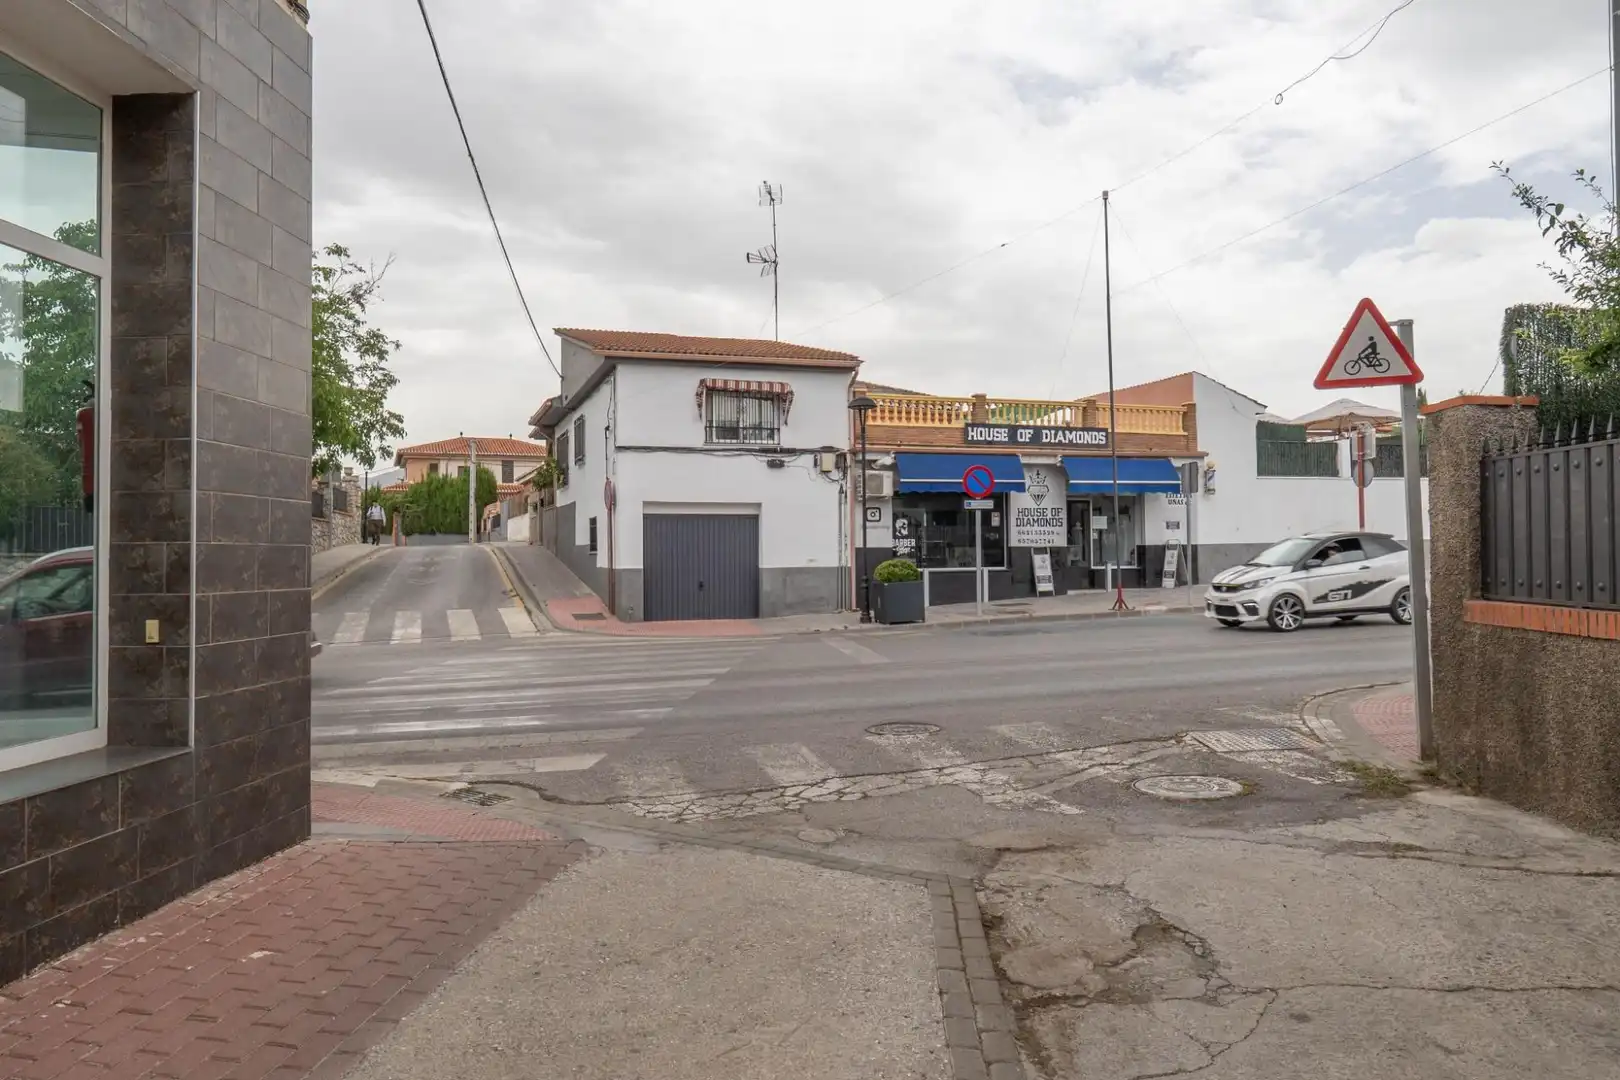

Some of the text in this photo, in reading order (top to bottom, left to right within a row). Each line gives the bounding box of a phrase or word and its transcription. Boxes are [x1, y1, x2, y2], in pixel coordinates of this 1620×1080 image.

[968, 427, 1106, 444] HOUSE OF DIAMONDS
[1017, 507, 1063, 517] HOUSE OF
[1016, 518, 1063, 527] DIAMONDS
[1328, 590, 1352, 601] GTI
